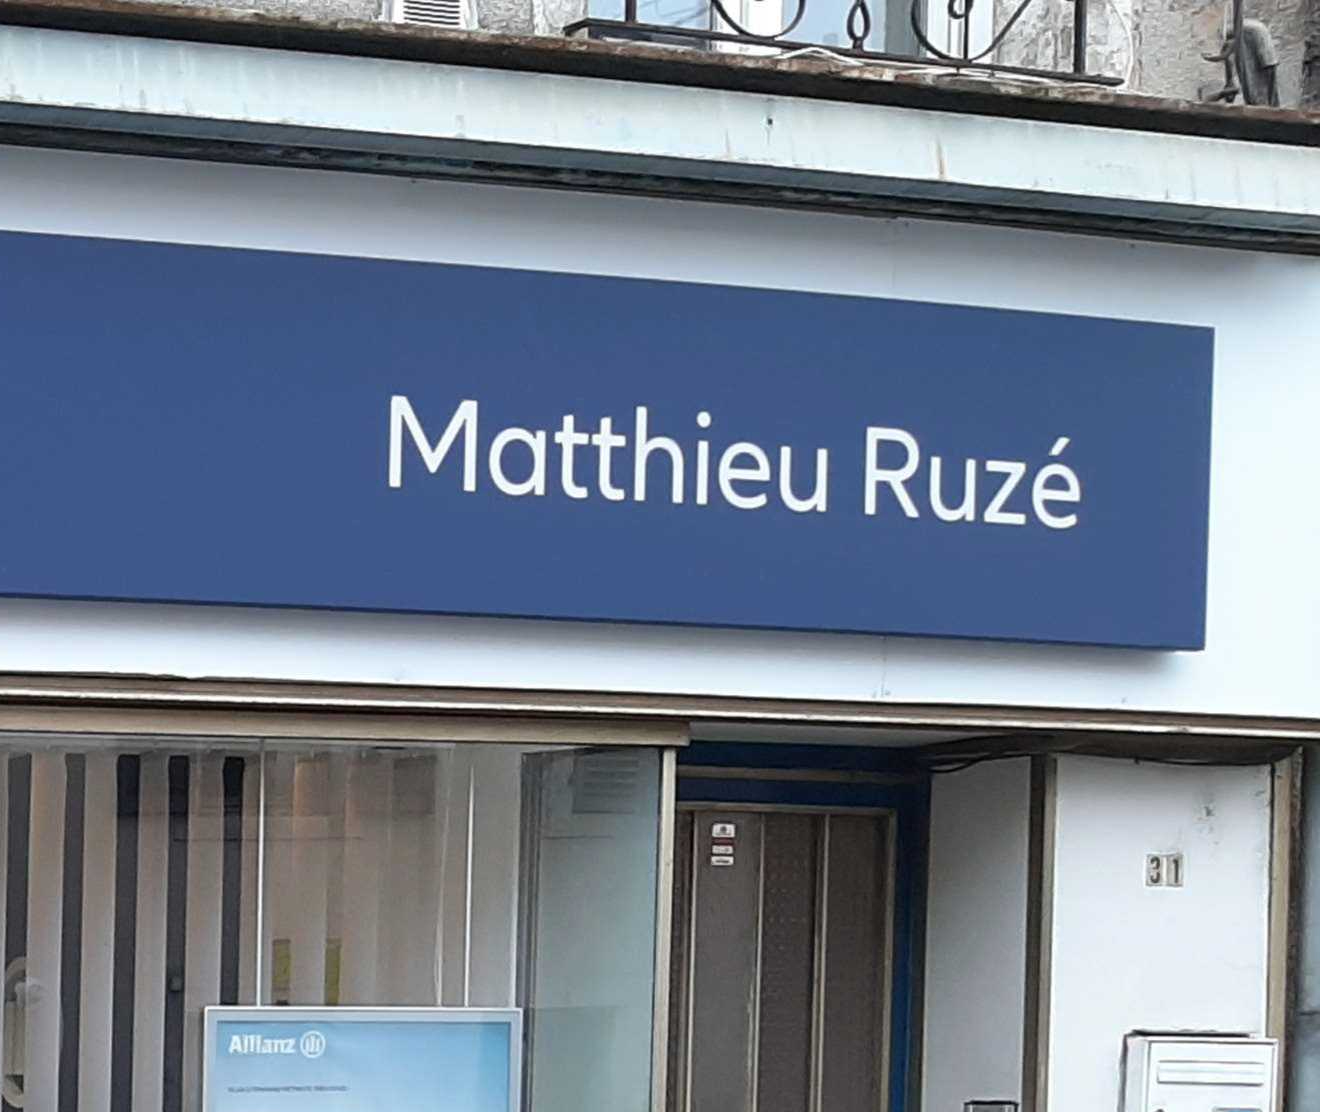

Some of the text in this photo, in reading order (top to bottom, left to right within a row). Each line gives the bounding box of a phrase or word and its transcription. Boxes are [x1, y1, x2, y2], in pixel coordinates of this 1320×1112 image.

[388, 395, 1082, 529] Matthieu Ruzé
[1149, 855, 1180, 884] 31
[228, 1034, 297, 1056] Allianz
